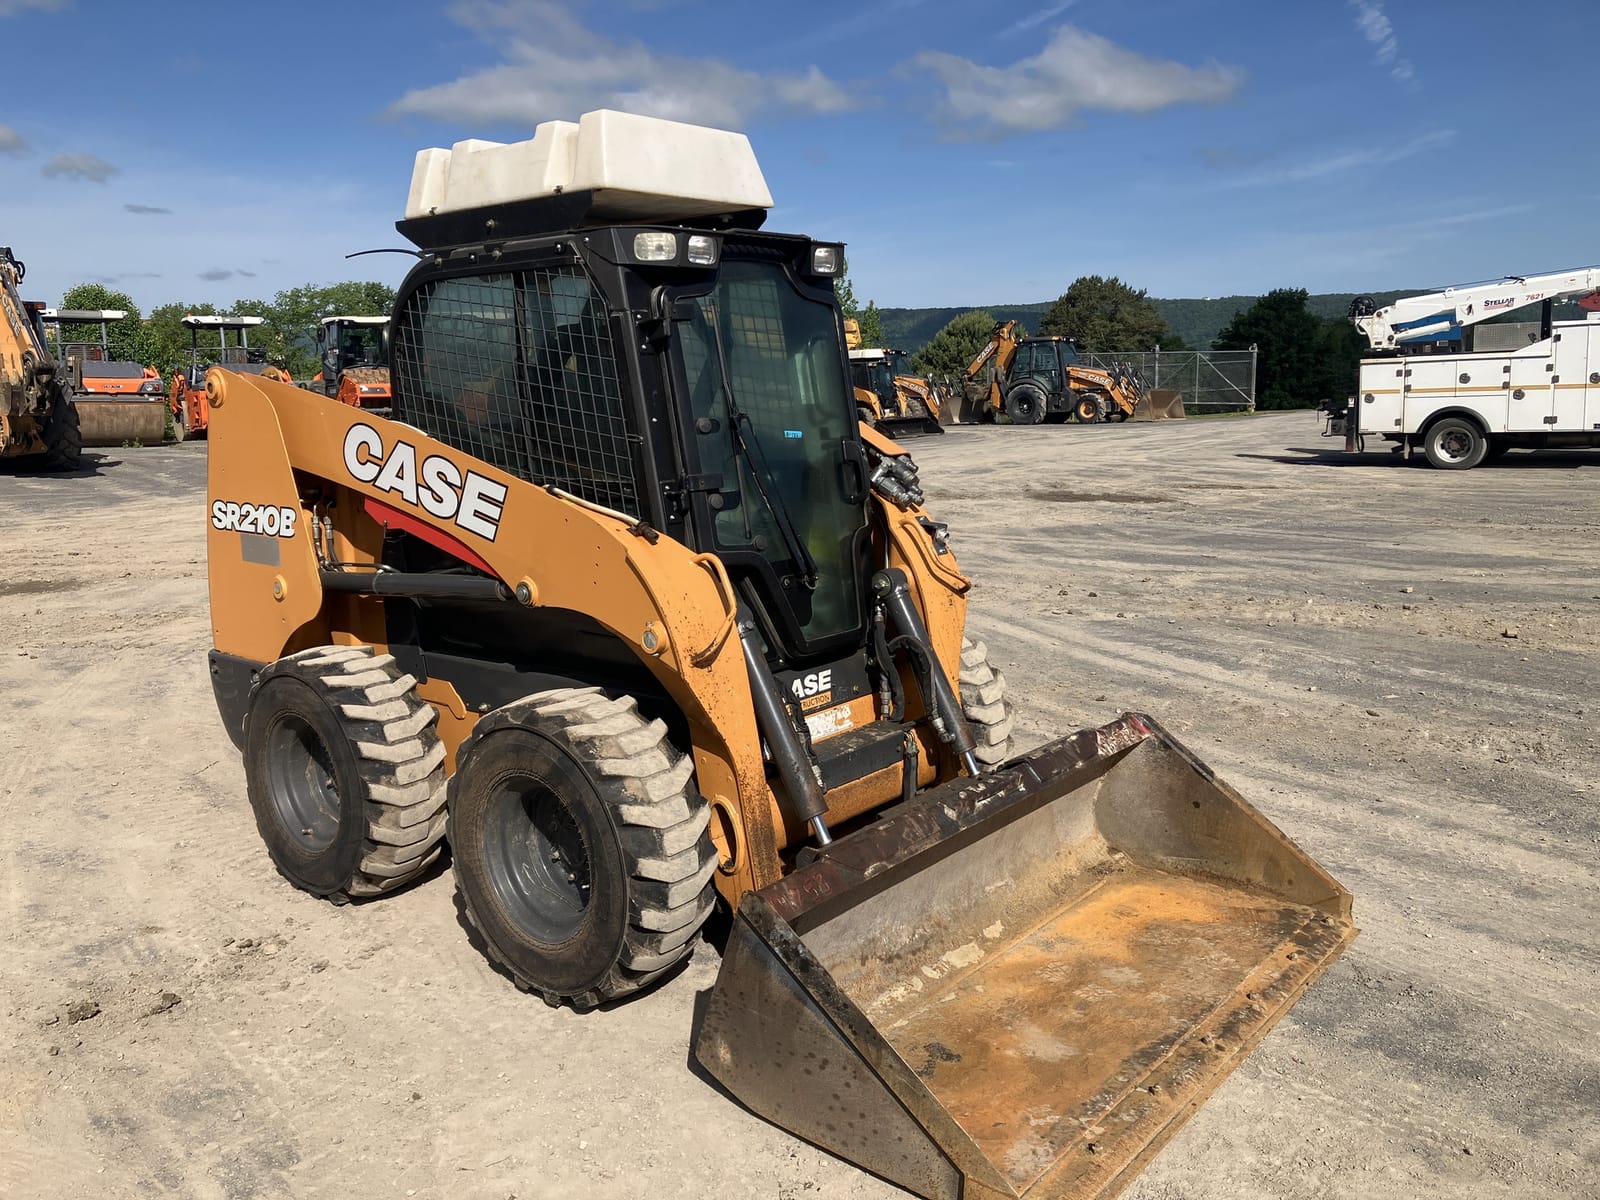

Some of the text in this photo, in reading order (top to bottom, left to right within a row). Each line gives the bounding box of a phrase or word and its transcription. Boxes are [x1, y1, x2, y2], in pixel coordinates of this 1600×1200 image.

[1483, 293, 1544, 307] STELLAR 7621
[976, 341, 995, 363] CASE
[1087, 373, 1111, 386] CASE
[343, 422, 509, 543] CASE
[211, 499, 297, 538] SR210B
[791, 669, 832, 699] ASE
